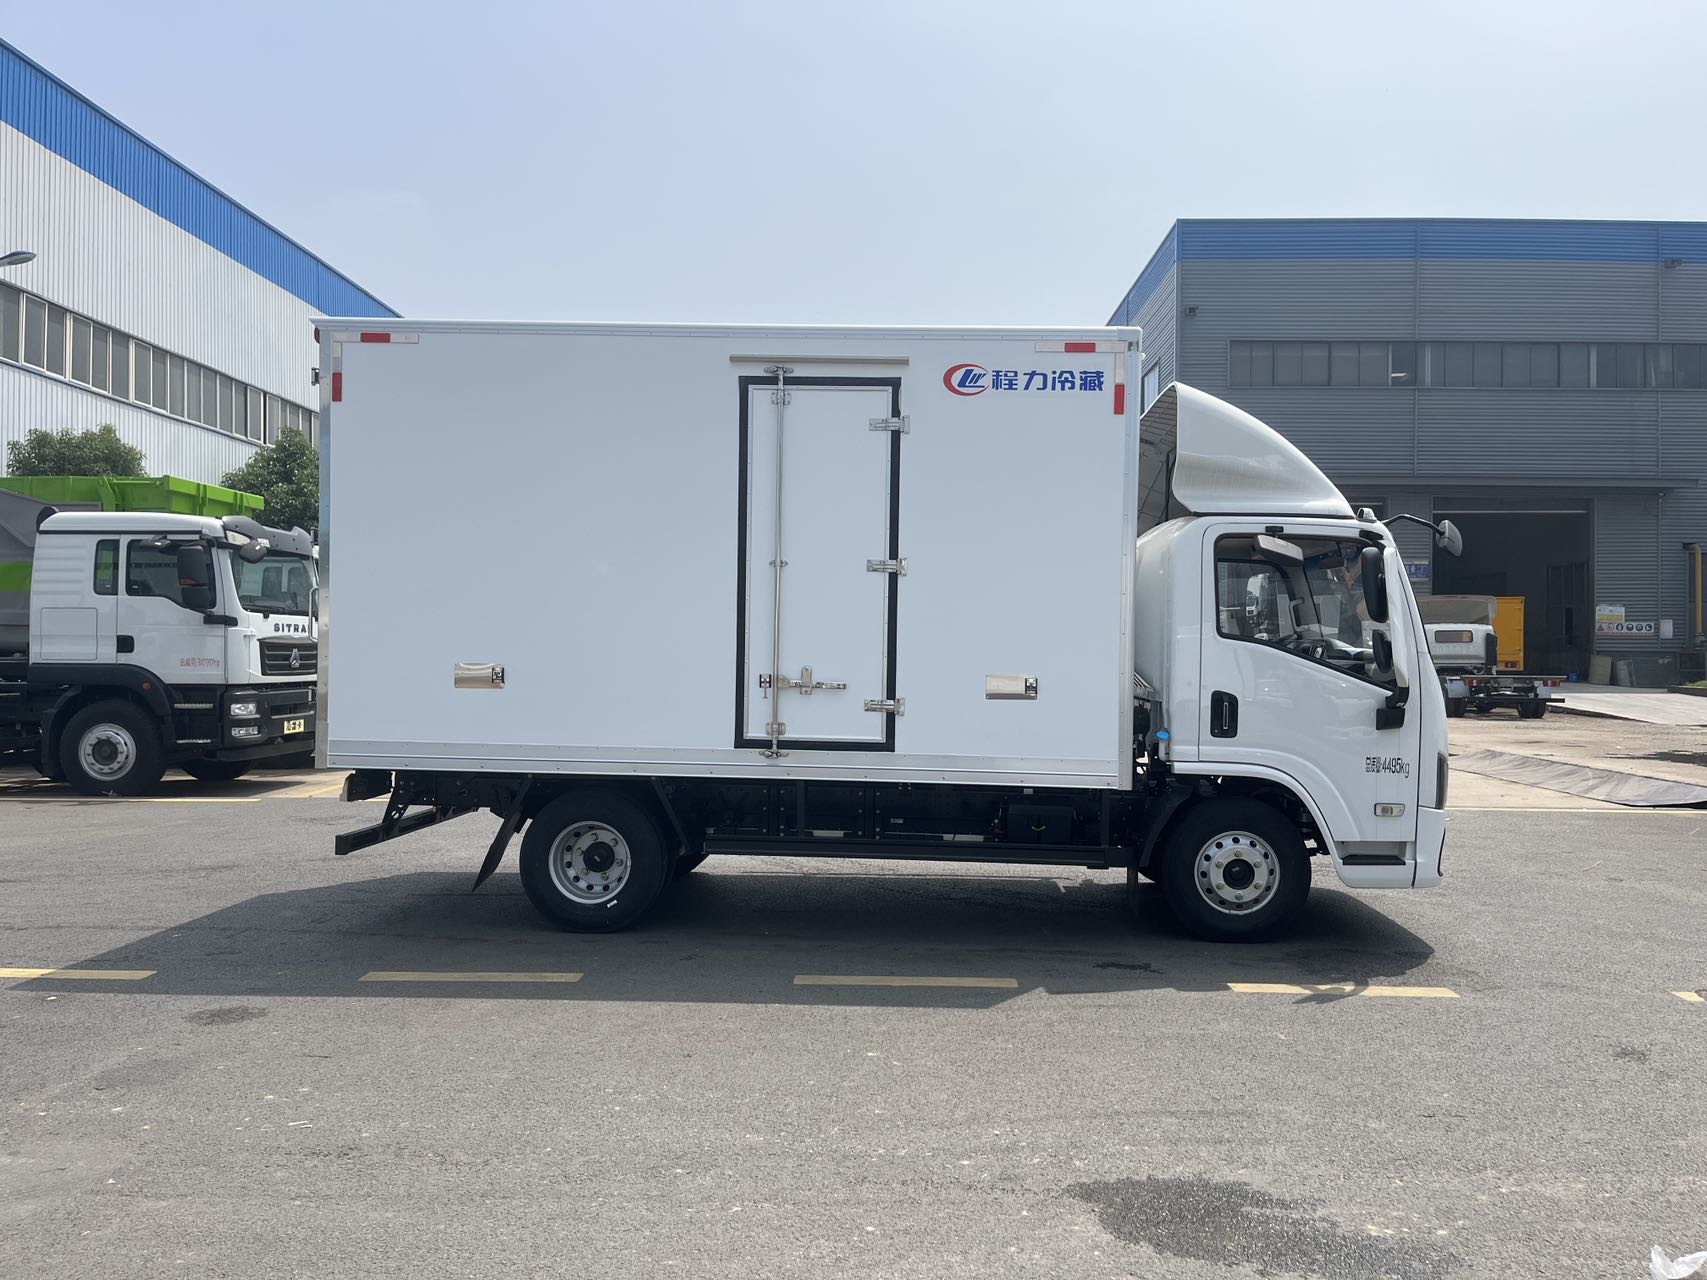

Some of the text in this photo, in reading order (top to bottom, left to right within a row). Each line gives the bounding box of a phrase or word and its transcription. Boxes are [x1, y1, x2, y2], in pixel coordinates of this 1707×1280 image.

[992, 370, 1104, 392] 程力冷藏
[273, 622, 309, 634] SITRA
